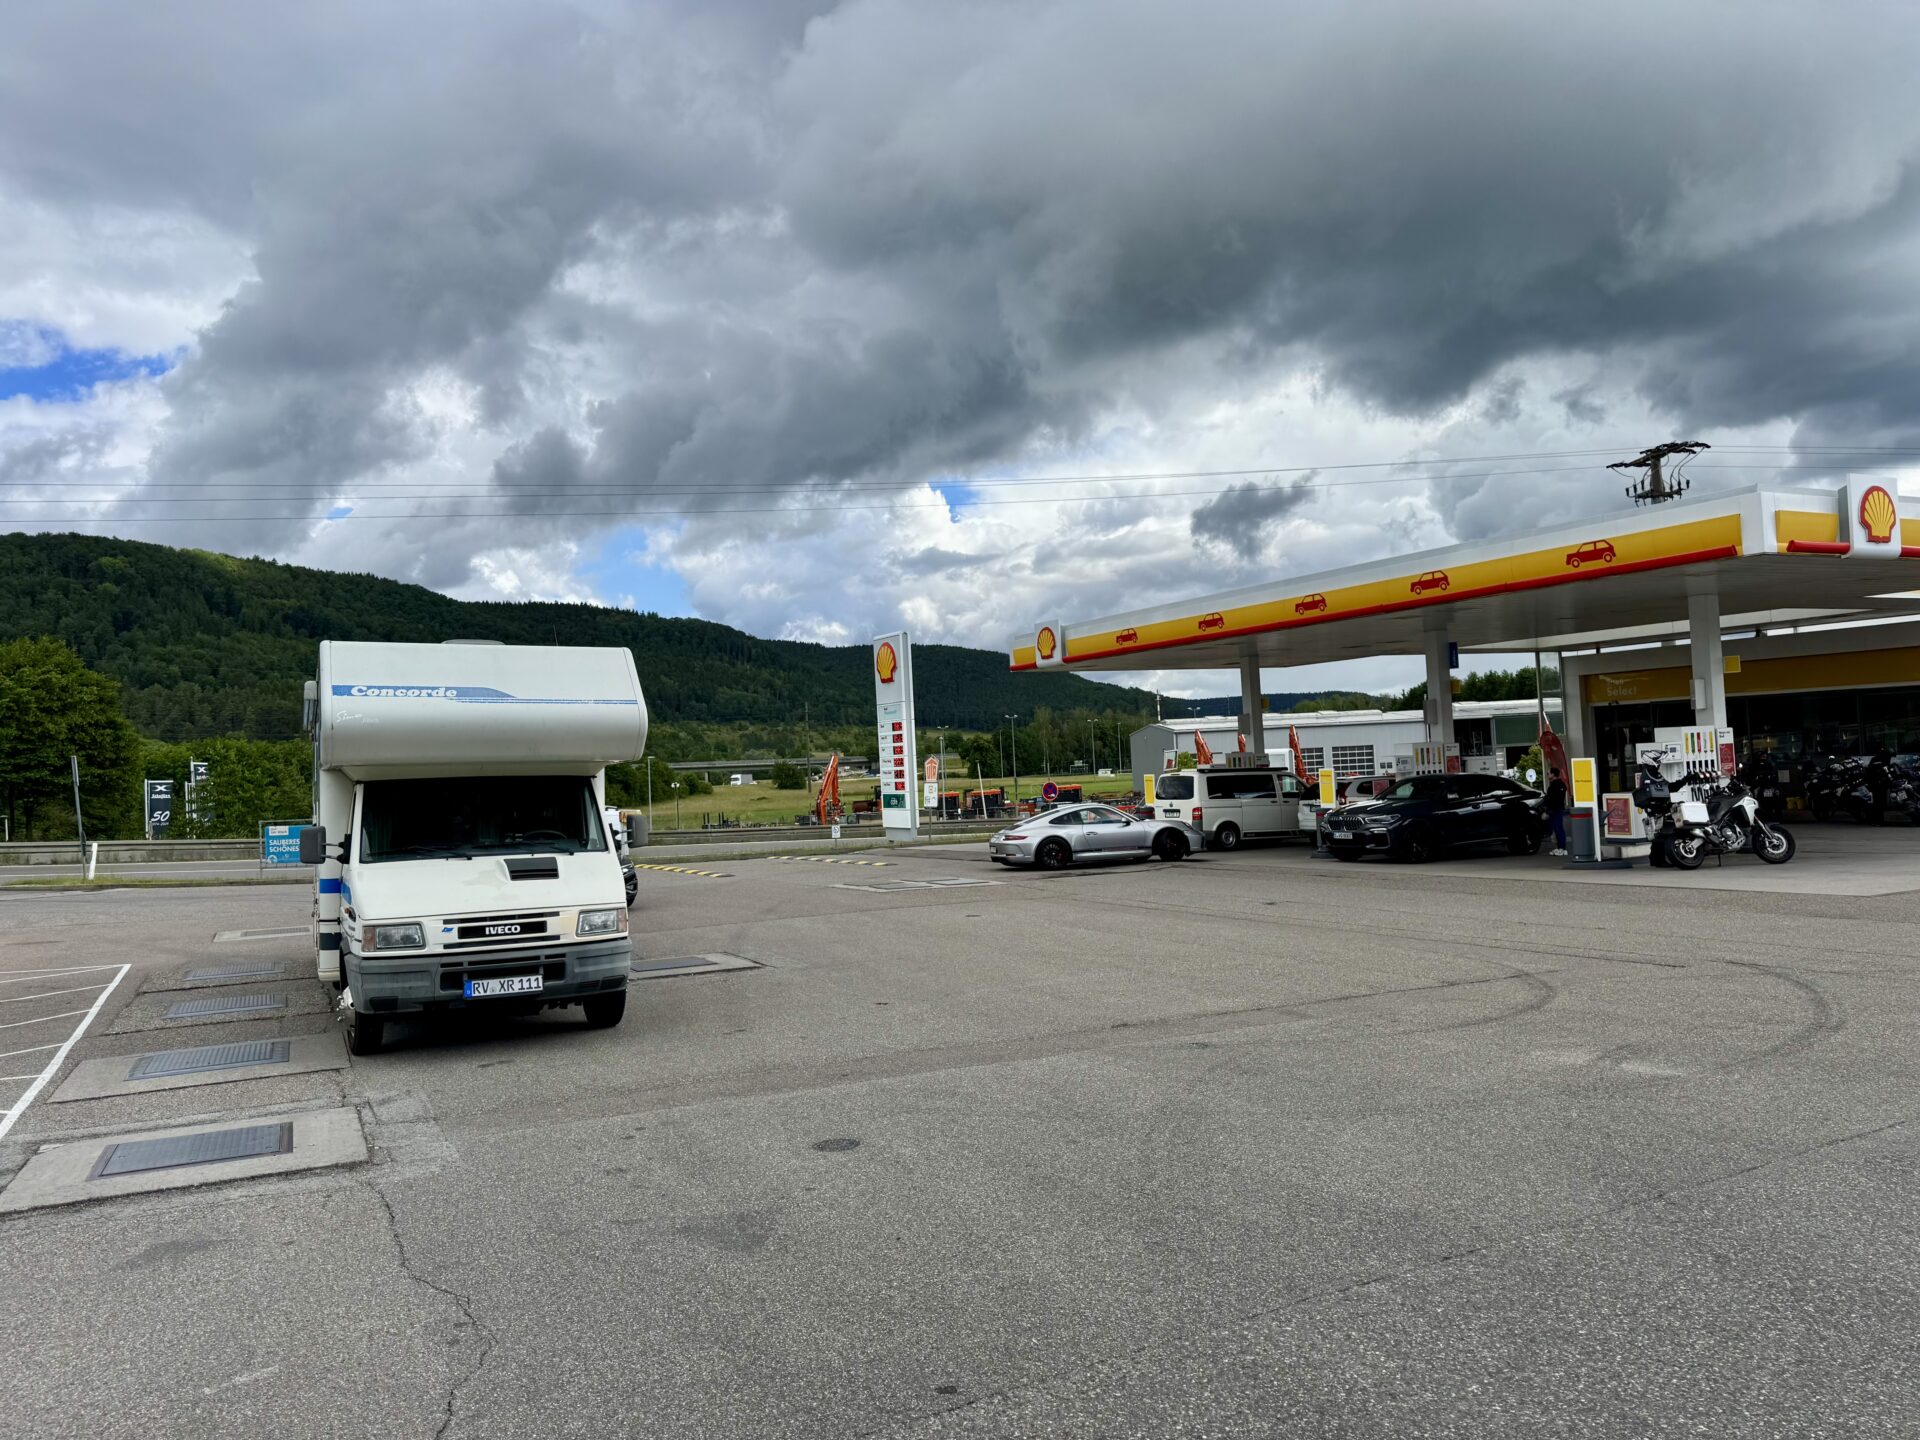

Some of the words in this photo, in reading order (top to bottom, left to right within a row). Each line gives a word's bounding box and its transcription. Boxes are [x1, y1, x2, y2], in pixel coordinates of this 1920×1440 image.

[351, 685, 457, 697] Concorde
[1607, 686, 1638, 697] Select
[150, 810, 170, 821] 50
[269, 838, 300, 846] SAUBERES
[485, 925, 520, 935] IVECO
[472, 981, 490, 995] RV
[498, 979, 515, 993] XR
[518, 977, 542, 991] 111
